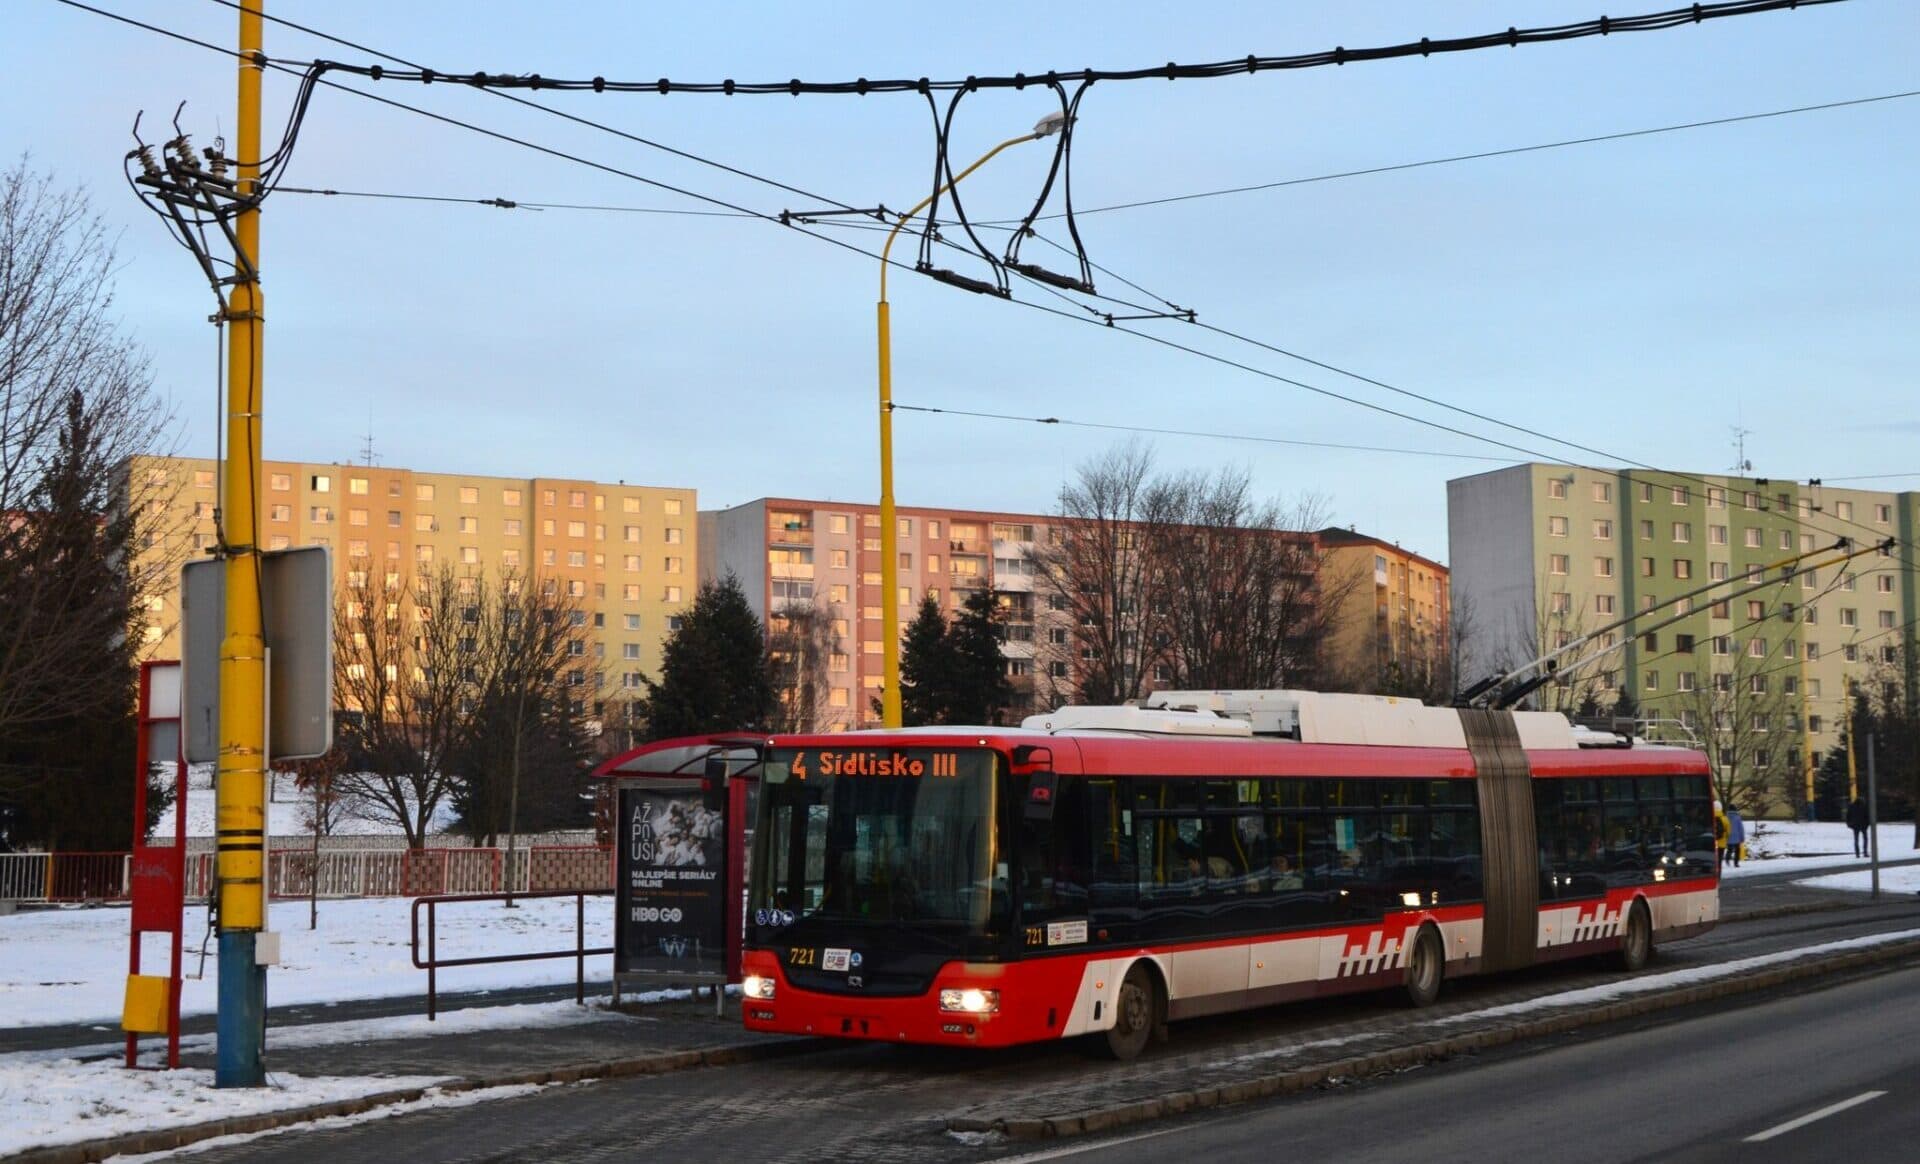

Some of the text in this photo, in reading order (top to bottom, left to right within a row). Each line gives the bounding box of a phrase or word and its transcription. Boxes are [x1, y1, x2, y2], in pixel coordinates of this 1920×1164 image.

[792, 752, 806, 779] 4
[933, 753, 957, 776] III
[632, 802, 652, 823] AŽ
[632, 839, 655, 860] UŠI
[679, 869, 717, 880] SERIÁLY
[632, 879, 663, 888] ONLINE
[632, 907, 682, 922] HBO GO
[1026, 928, 1042, 944] 721
[790, 948, 815, 965] 721
